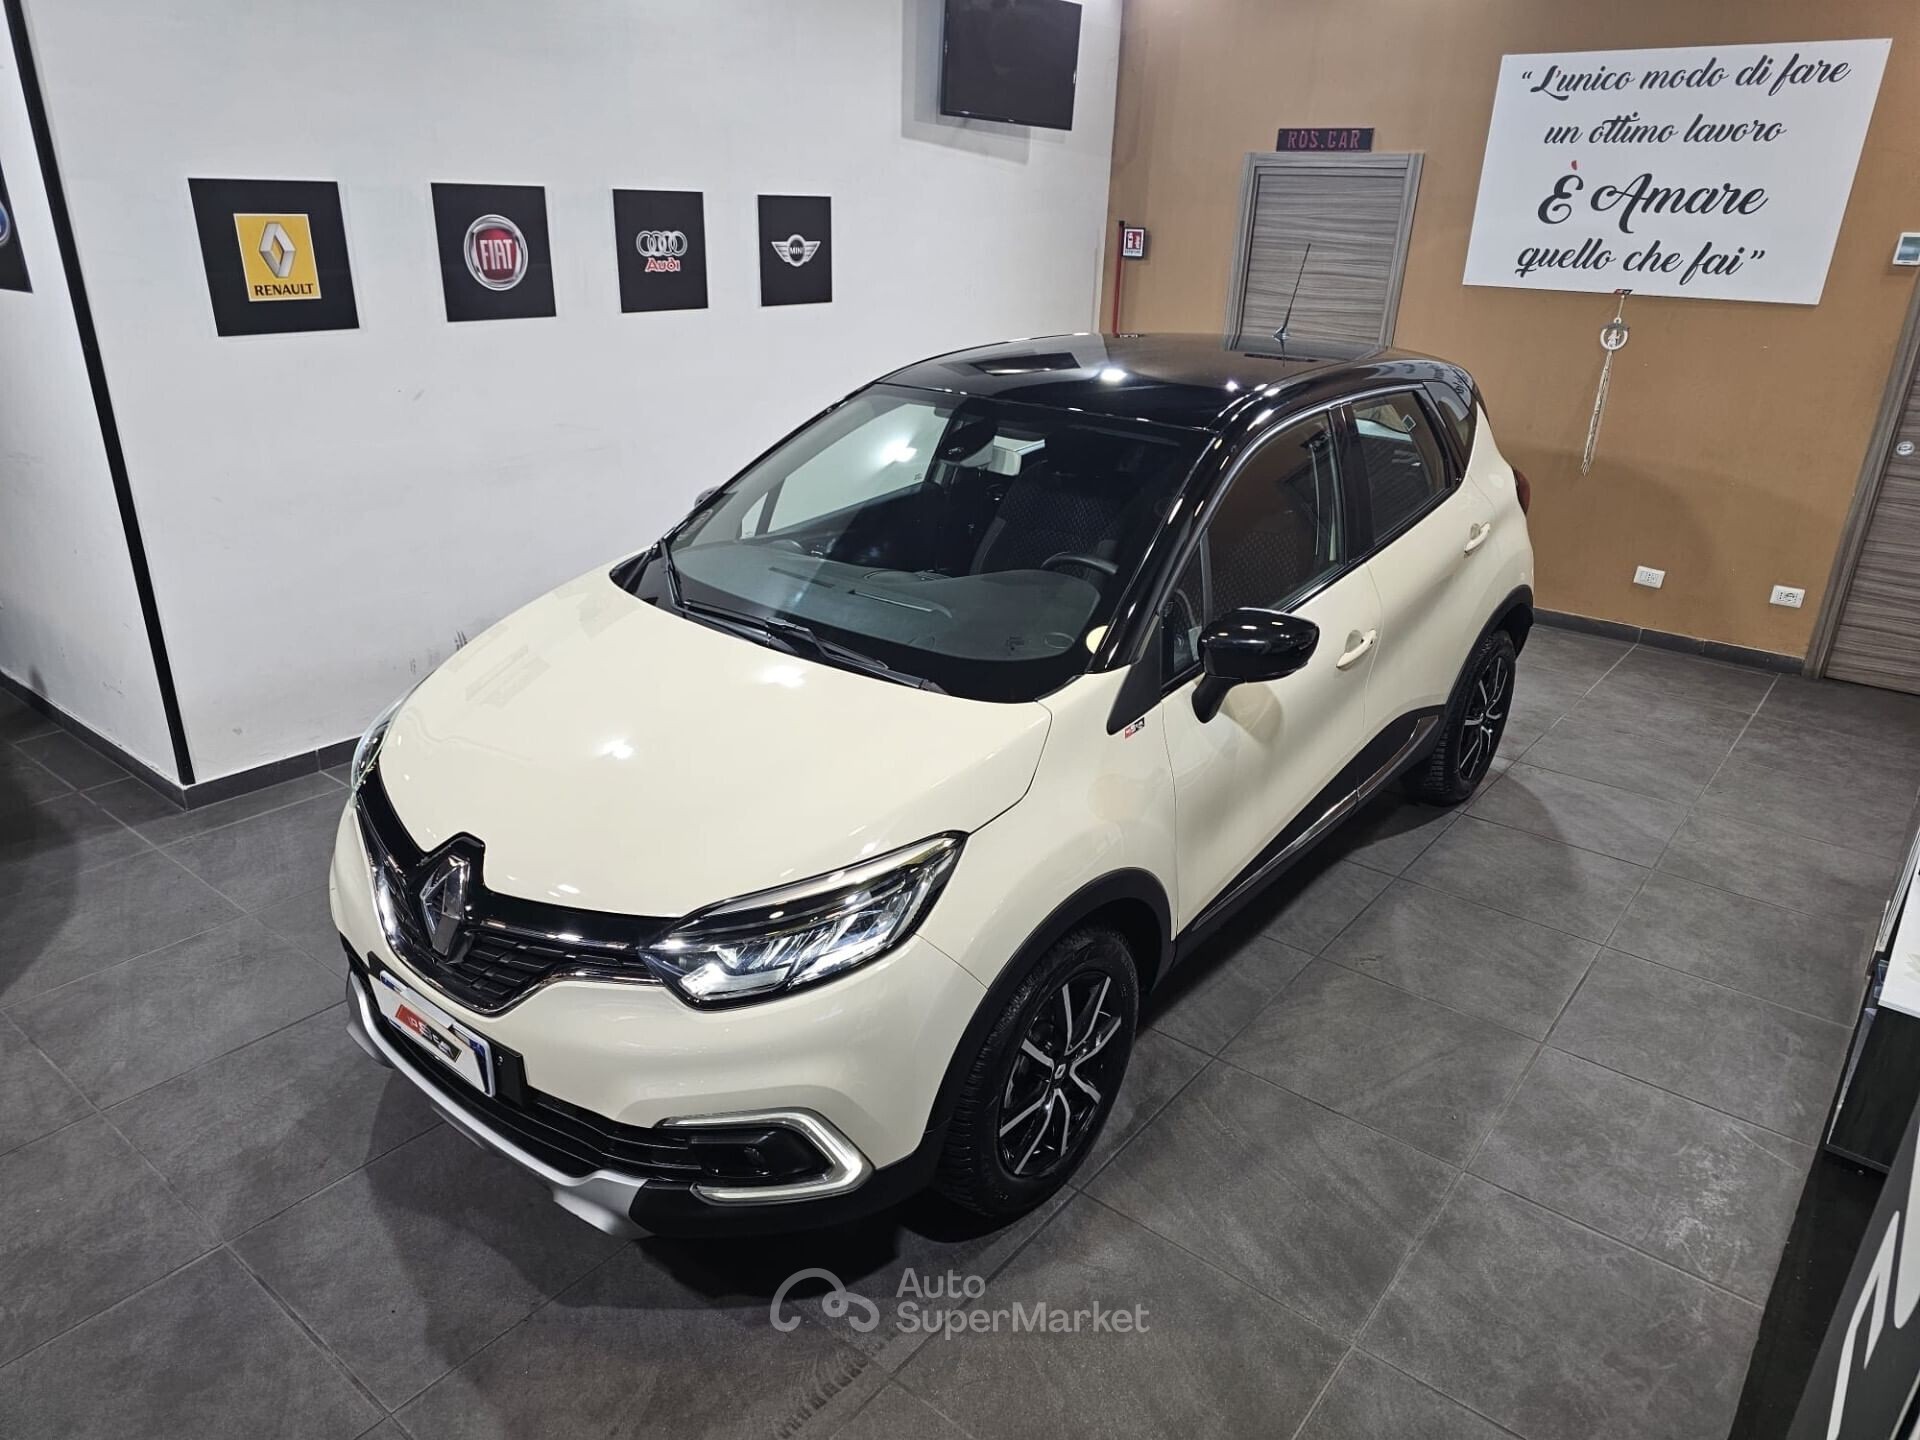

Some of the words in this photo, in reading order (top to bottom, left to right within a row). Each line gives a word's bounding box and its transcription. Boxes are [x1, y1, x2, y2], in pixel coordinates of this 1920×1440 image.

[1639, 57, 1728, 90] modo
[1735, 54, 1771, 87] di
[1768, 53, 1851, 97] fare
[1544, 122, 1583, 145] un
[1588, 112, 1679, 145] ottimo
[1683, 113, 1787, 144] lavoro
[1537, 160, 1584, 225] È
[1590, 173, 1769, 234] Amare
[479, 239, 513, 271] FIAT
[645, 257, 681, 272] Audi
[1515, 238, 1617, 278] quello
[1622, 240, 1682, 274] che
[254, 283, 314, 297] RENAULT
